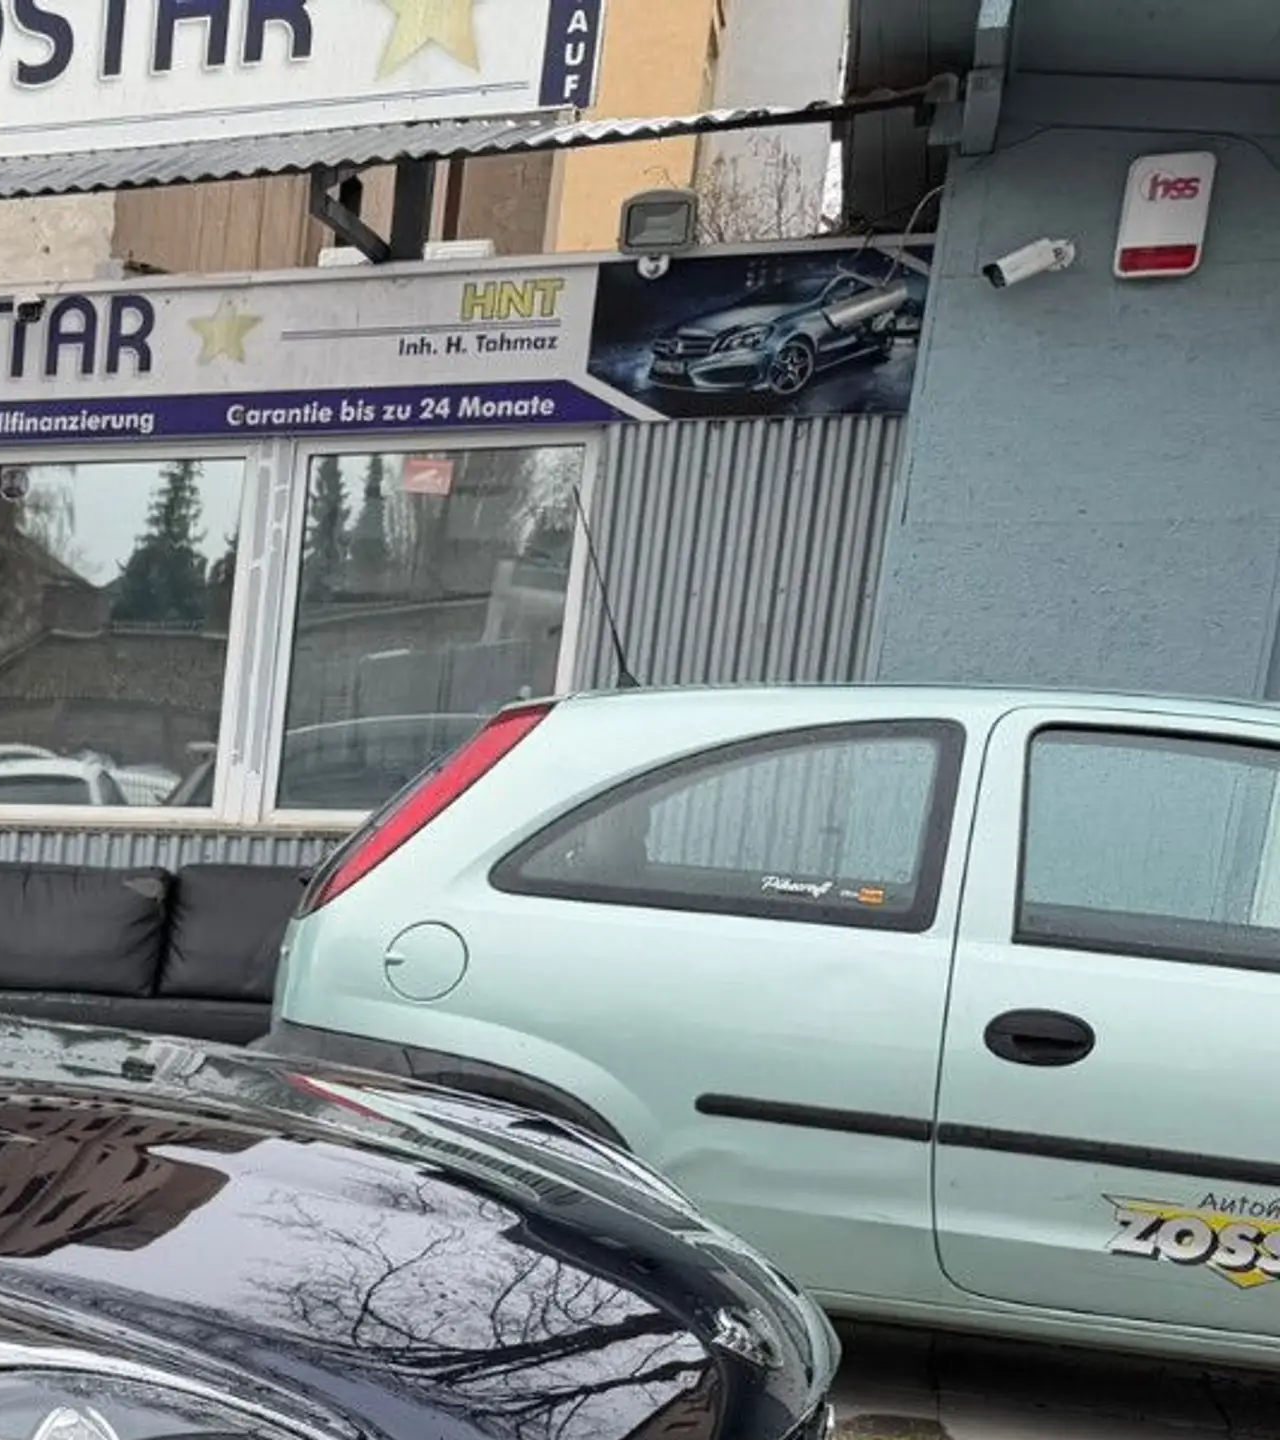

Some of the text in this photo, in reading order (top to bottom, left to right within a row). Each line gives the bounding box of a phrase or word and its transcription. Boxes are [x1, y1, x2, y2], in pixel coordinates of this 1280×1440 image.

[563, 1, 589, 99] AUF
[1147, 172, 1201, 201] hss
[461, 277, 565, 321] HNT
[398, 331, 559, 356] Inh. H. Tahmaz
[225, 401, 334, 426] Garantie
[339, 399, 376, 423] bis
[382, 406, 412, 421] zu
[418, 396, 451, 419] 24
[456, 394, 556, 418] Monate
